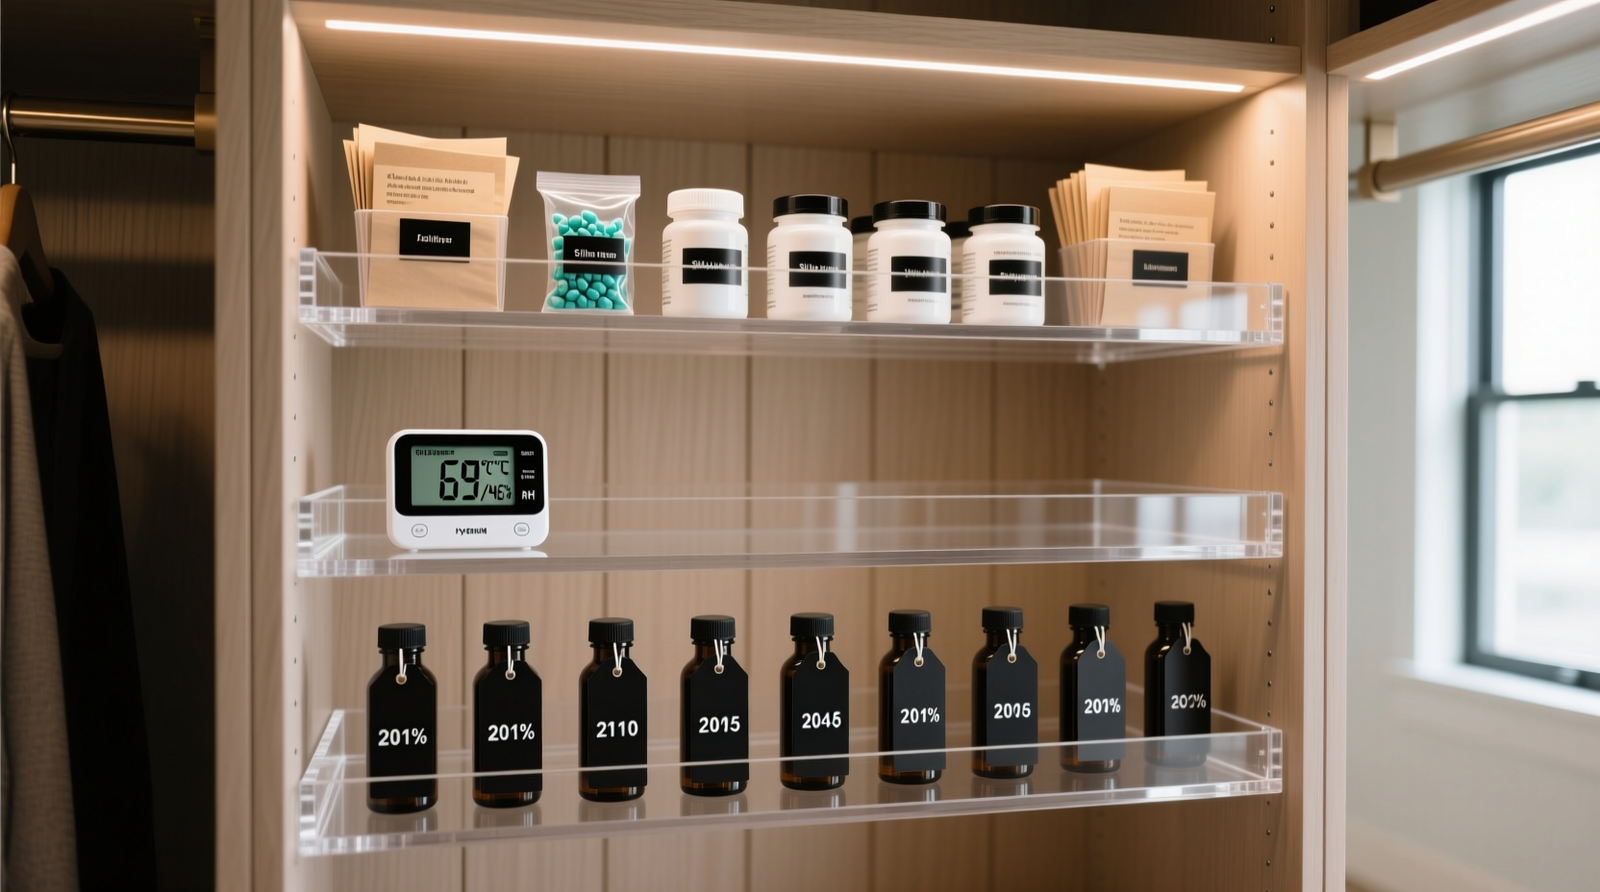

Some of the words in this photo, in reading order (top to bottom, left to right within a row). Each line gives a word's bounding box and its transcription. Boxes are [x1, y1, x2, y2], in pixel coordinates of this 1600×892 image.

[439, 460, 480, 501] 69
[1084, 698, 1121, 714] 201%
[699, 715, 740, 733] 2015
[900, 707, 940, 724] 201%
[378, 728, 427, 746] 201%
[488, 723, 535, 741] 201%
[596, 720, 638, 738] 2110
